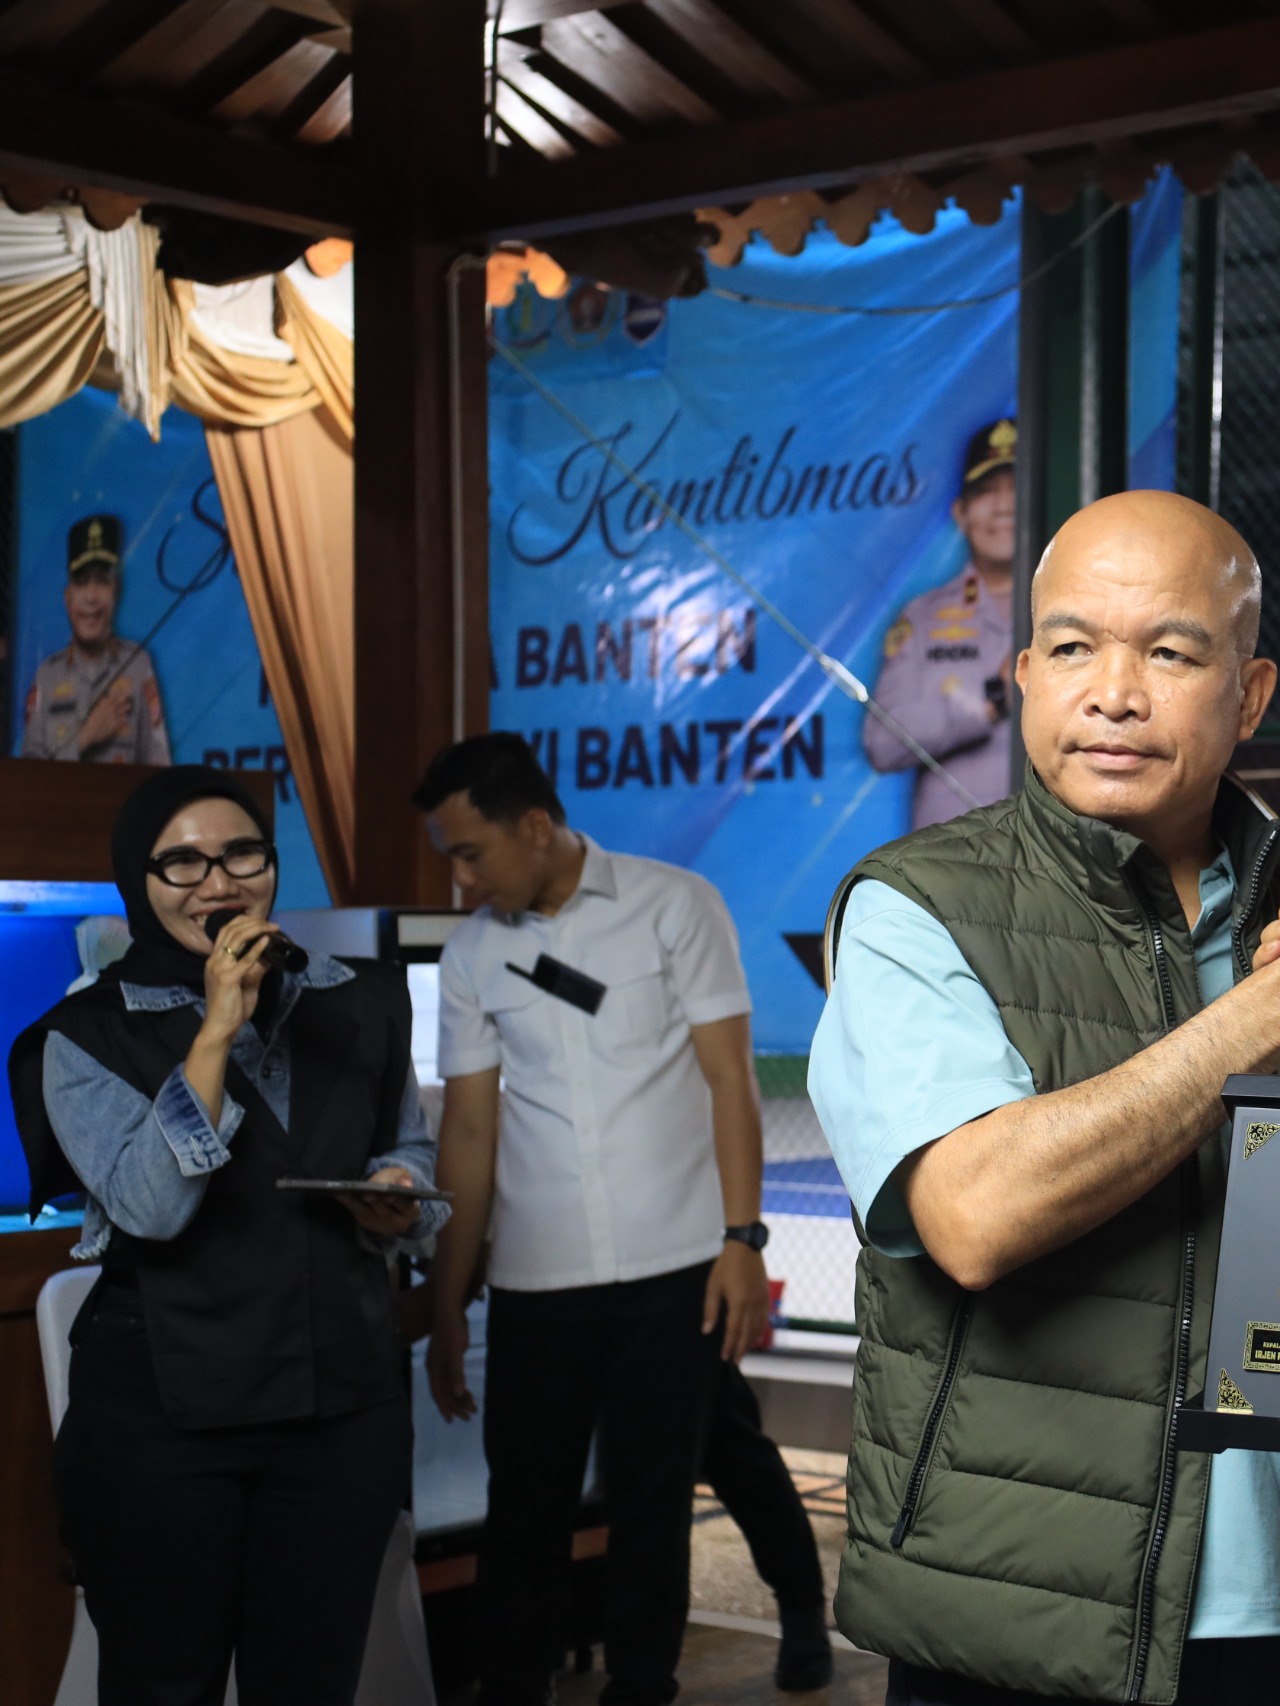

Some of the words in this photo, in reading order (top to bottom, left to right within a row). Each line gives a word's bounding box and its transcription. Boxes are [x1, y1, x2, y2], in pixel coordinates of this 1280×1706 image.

[507, 408, 925, 566] Kamtibmas
[515, 607, 757, 690] BANTEN
[575, 713, 825, 791] BANTEN
[1255, 1350, 1276, 1360] IRJEN
